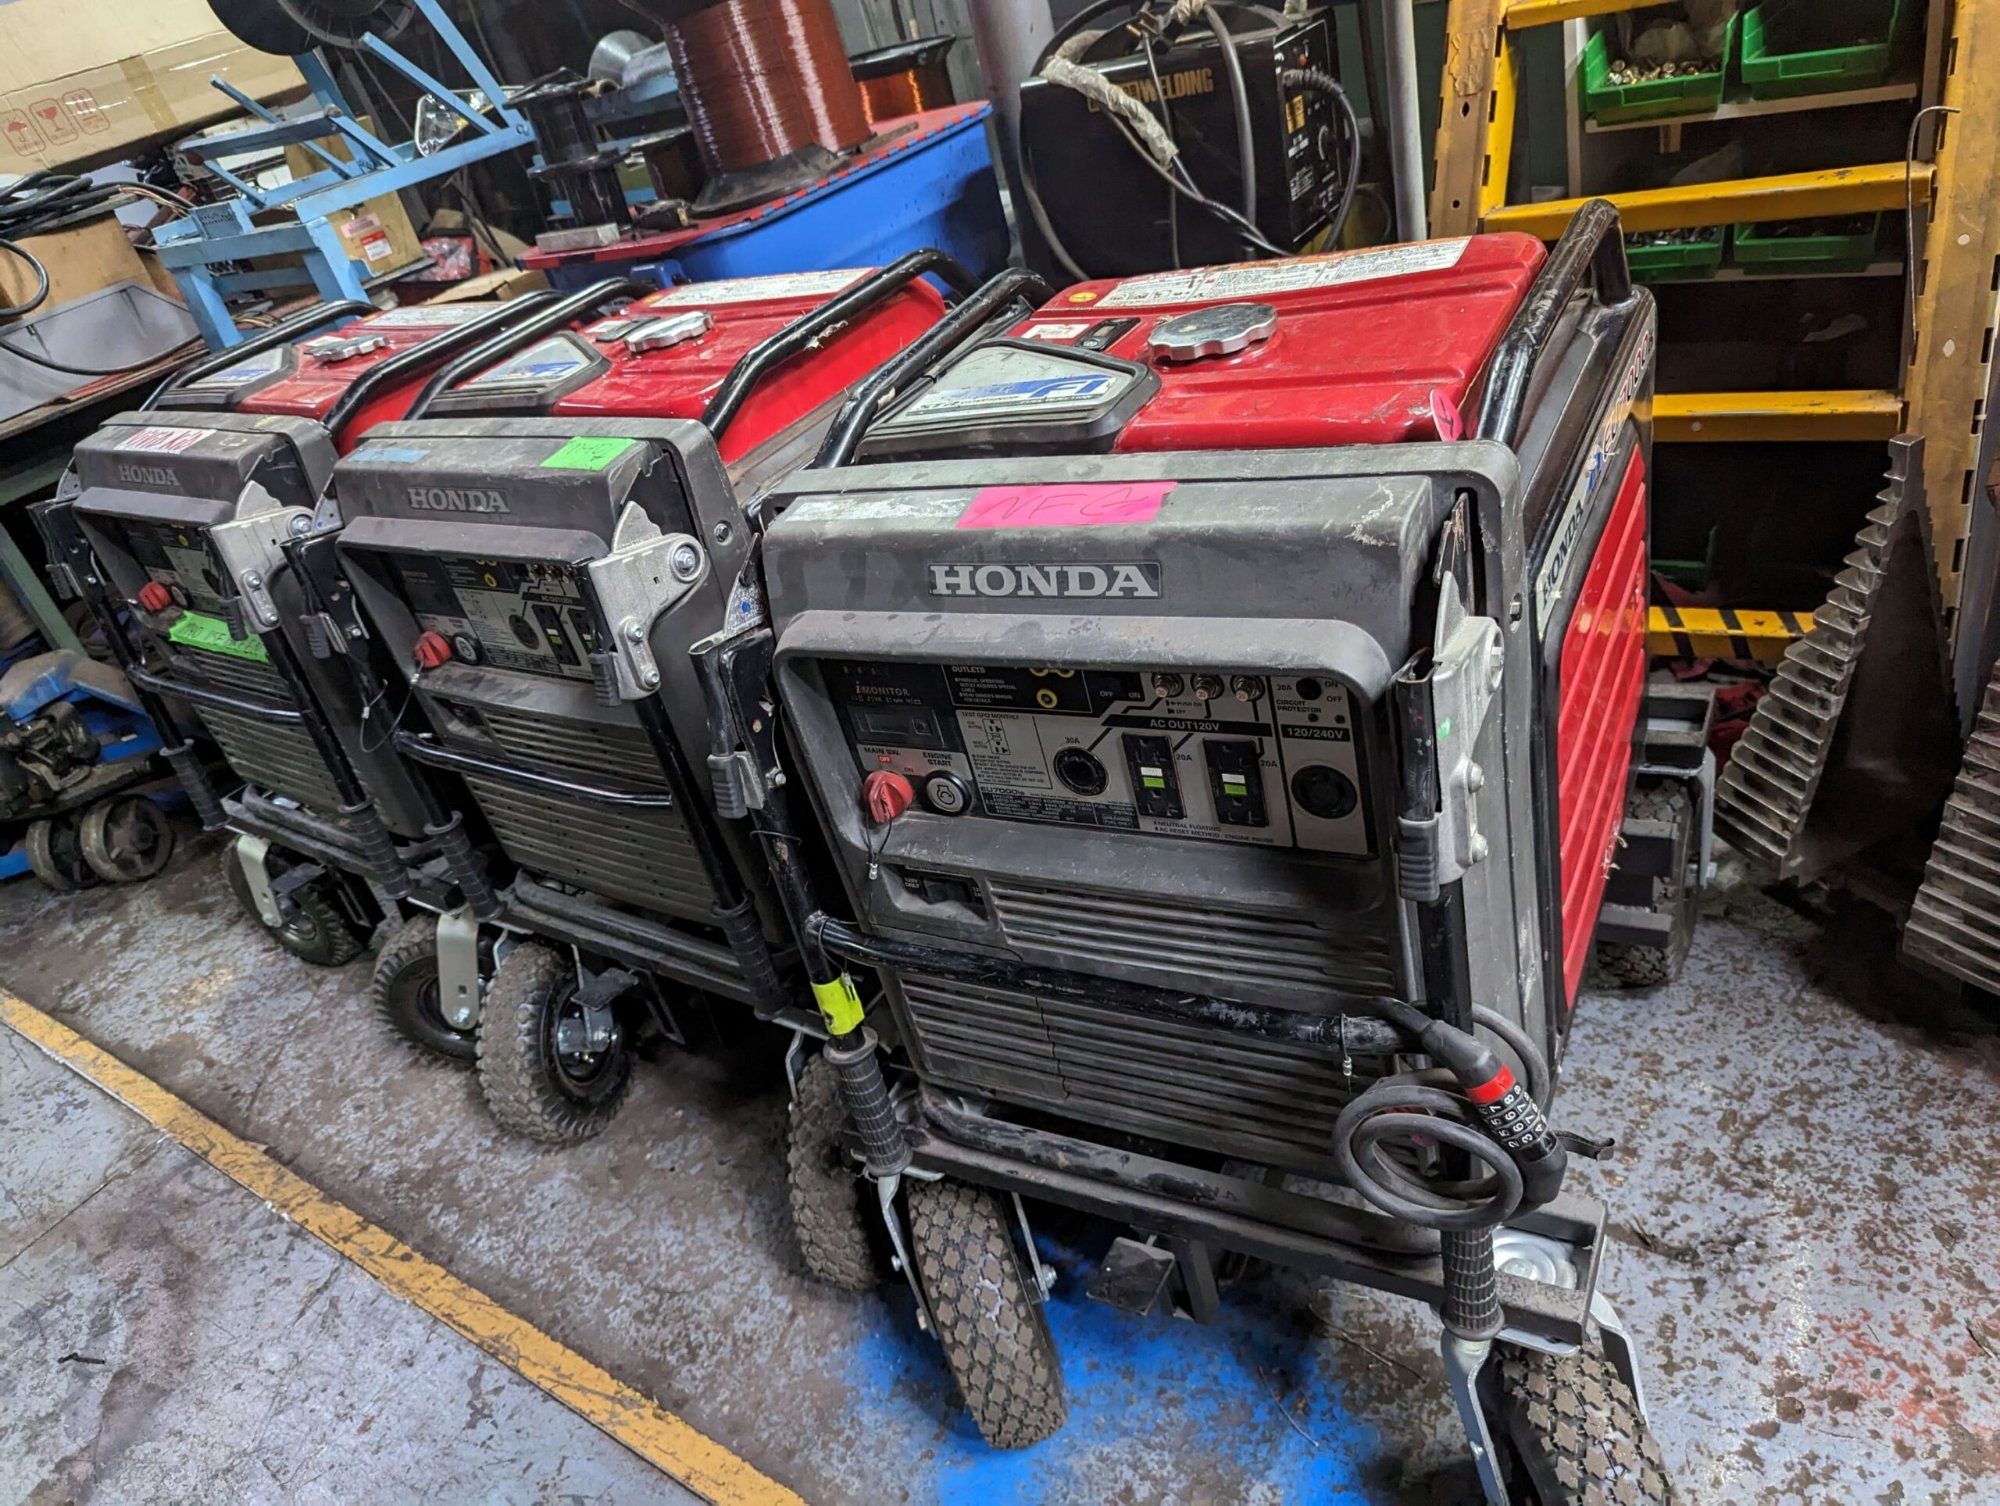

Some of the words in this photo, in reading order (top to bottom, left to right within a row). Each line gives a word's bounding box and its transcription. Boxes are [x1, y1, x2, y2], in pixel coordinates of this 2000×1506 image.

[1139, 67, 1214, 102] WELDING
[118, 464, 180, 487] HONDA
[407, 487, 511, 514] HONDA
[929, 564, 1160, 598] HONDA
[1324, 680, 1339, 688] ON
[1276, 699, 1307, 707] CIRCUIT
[1326, 695, 1343, 703] OFF
[1277, 705, 1322, 714] PROTECTOR
[1150, 718, 1167, 729] AC
[1168, 720, 1221, 732] OUT120V
[1287, 727, 1344, 740] 120/240V
[1065, 736, 1081, 744] 30A
[864, 746, 887, 756] MAIN
[922, 751, 953, 761] ENGINE
[1176, 753, 1192, 762] 20A
[927, 759, 952, 767] START
[1260, 759, 1278, 768] 20A
